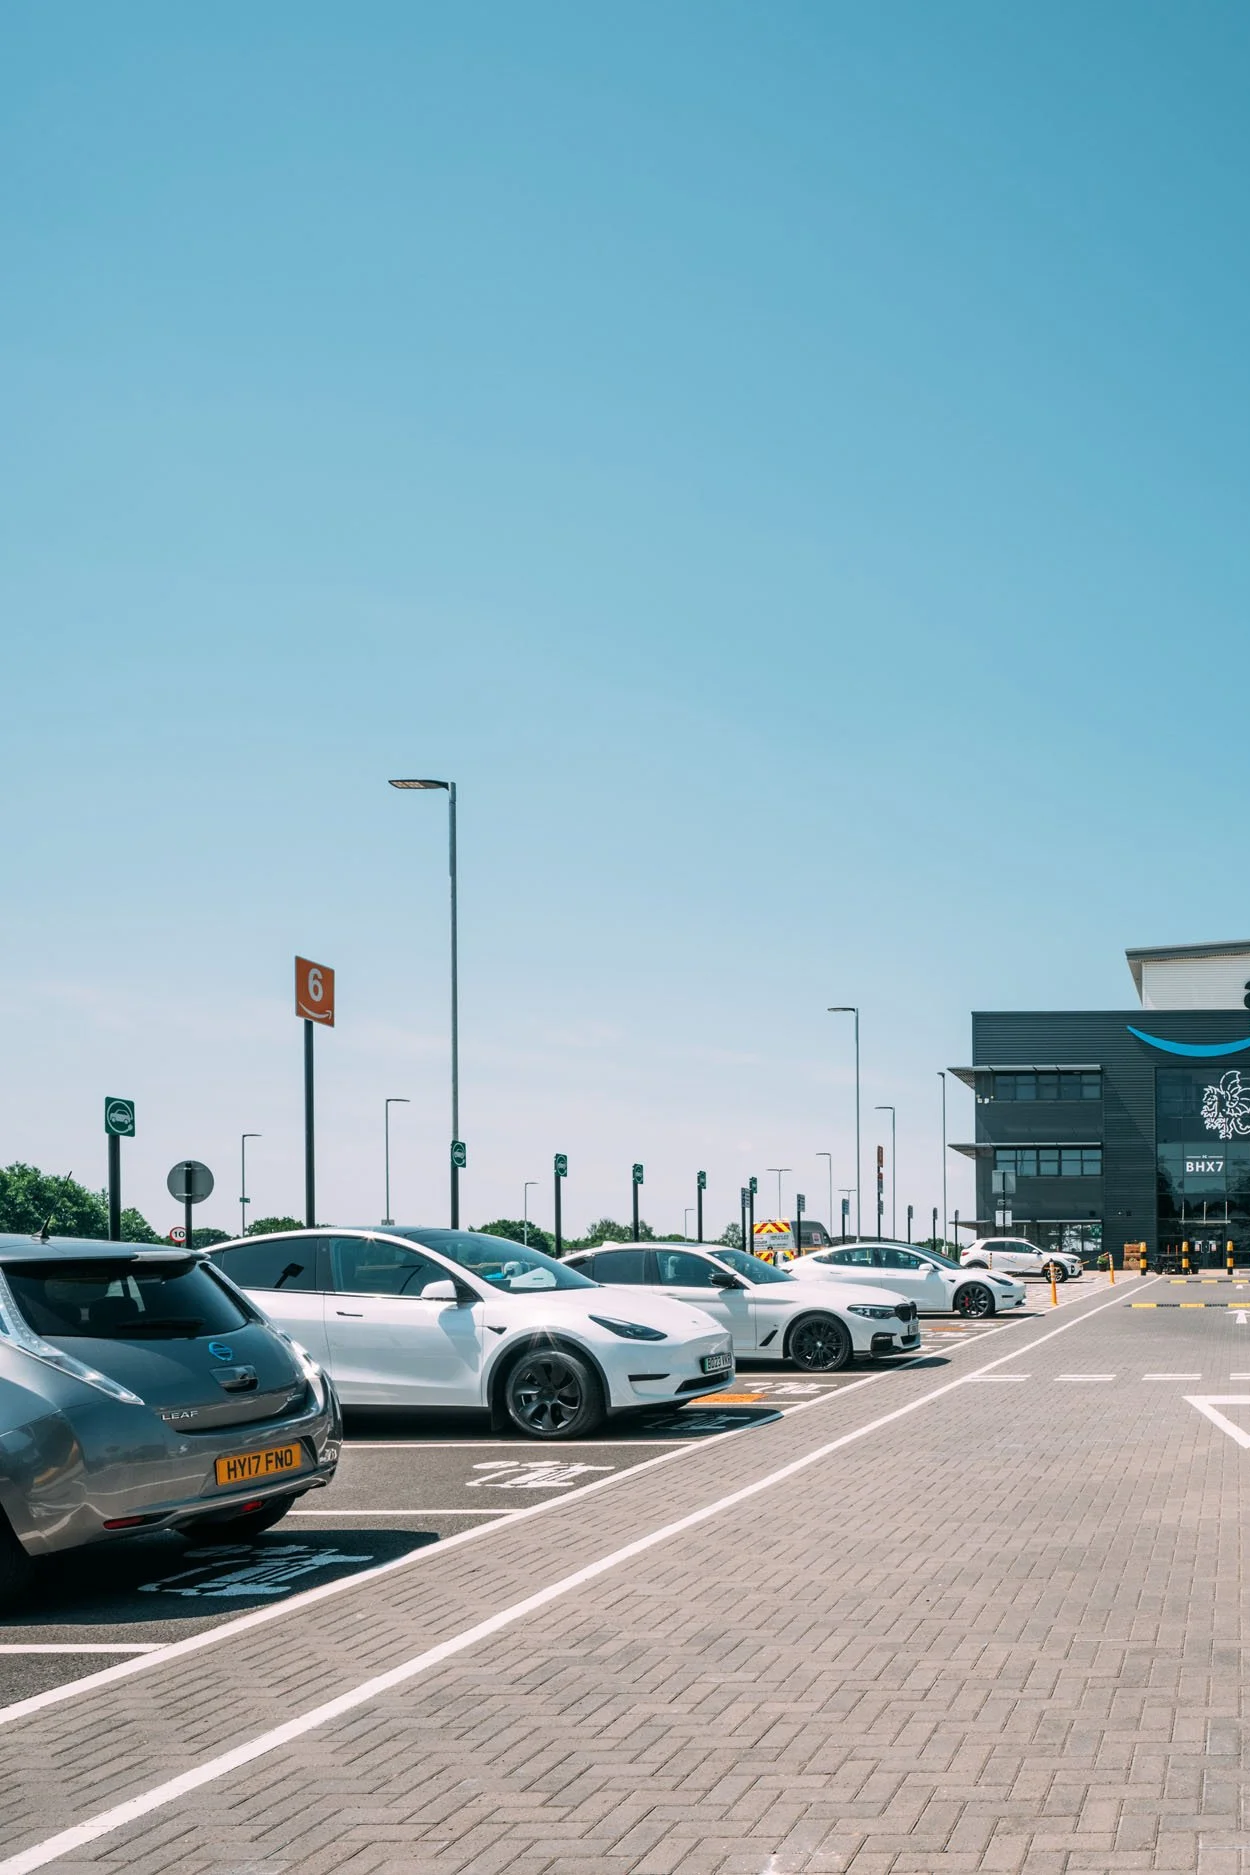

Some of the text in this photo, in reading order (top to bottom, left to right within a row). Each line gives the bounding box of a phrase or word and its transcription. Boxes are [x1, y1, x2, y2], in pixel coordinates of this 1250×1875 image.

[307, 967, 324, 1002] 6
[1186, 1161, 1224, 1172] BHX7
[162, 1410, 198, 1420] LEAF
[227, 1449, 293, 1480] HY17 FNO
